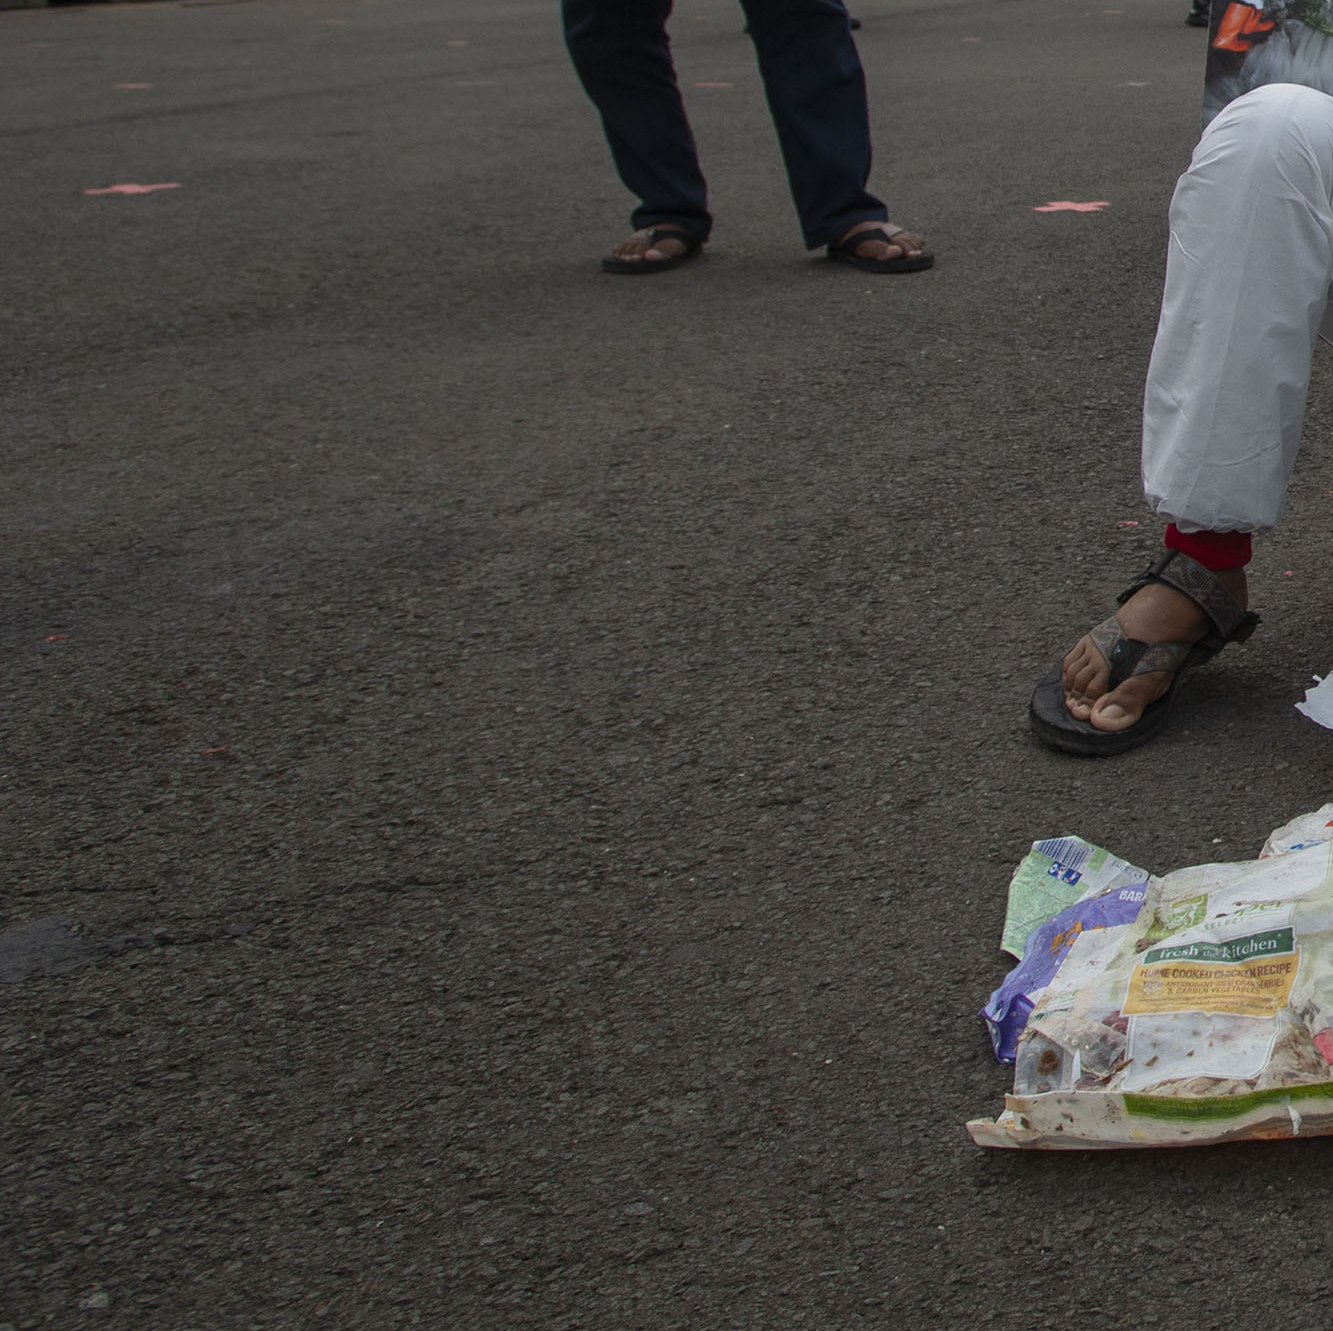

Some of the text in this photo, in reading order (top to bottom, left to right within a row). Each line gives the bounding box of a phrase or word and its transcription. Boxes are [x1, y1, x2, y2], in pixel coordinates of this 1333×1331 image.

[1222, 939, 1277, 959] kitchen
[1172, 968, 1212, 979] COOKED
[1257, 962, 1292, 976] RECIPE
